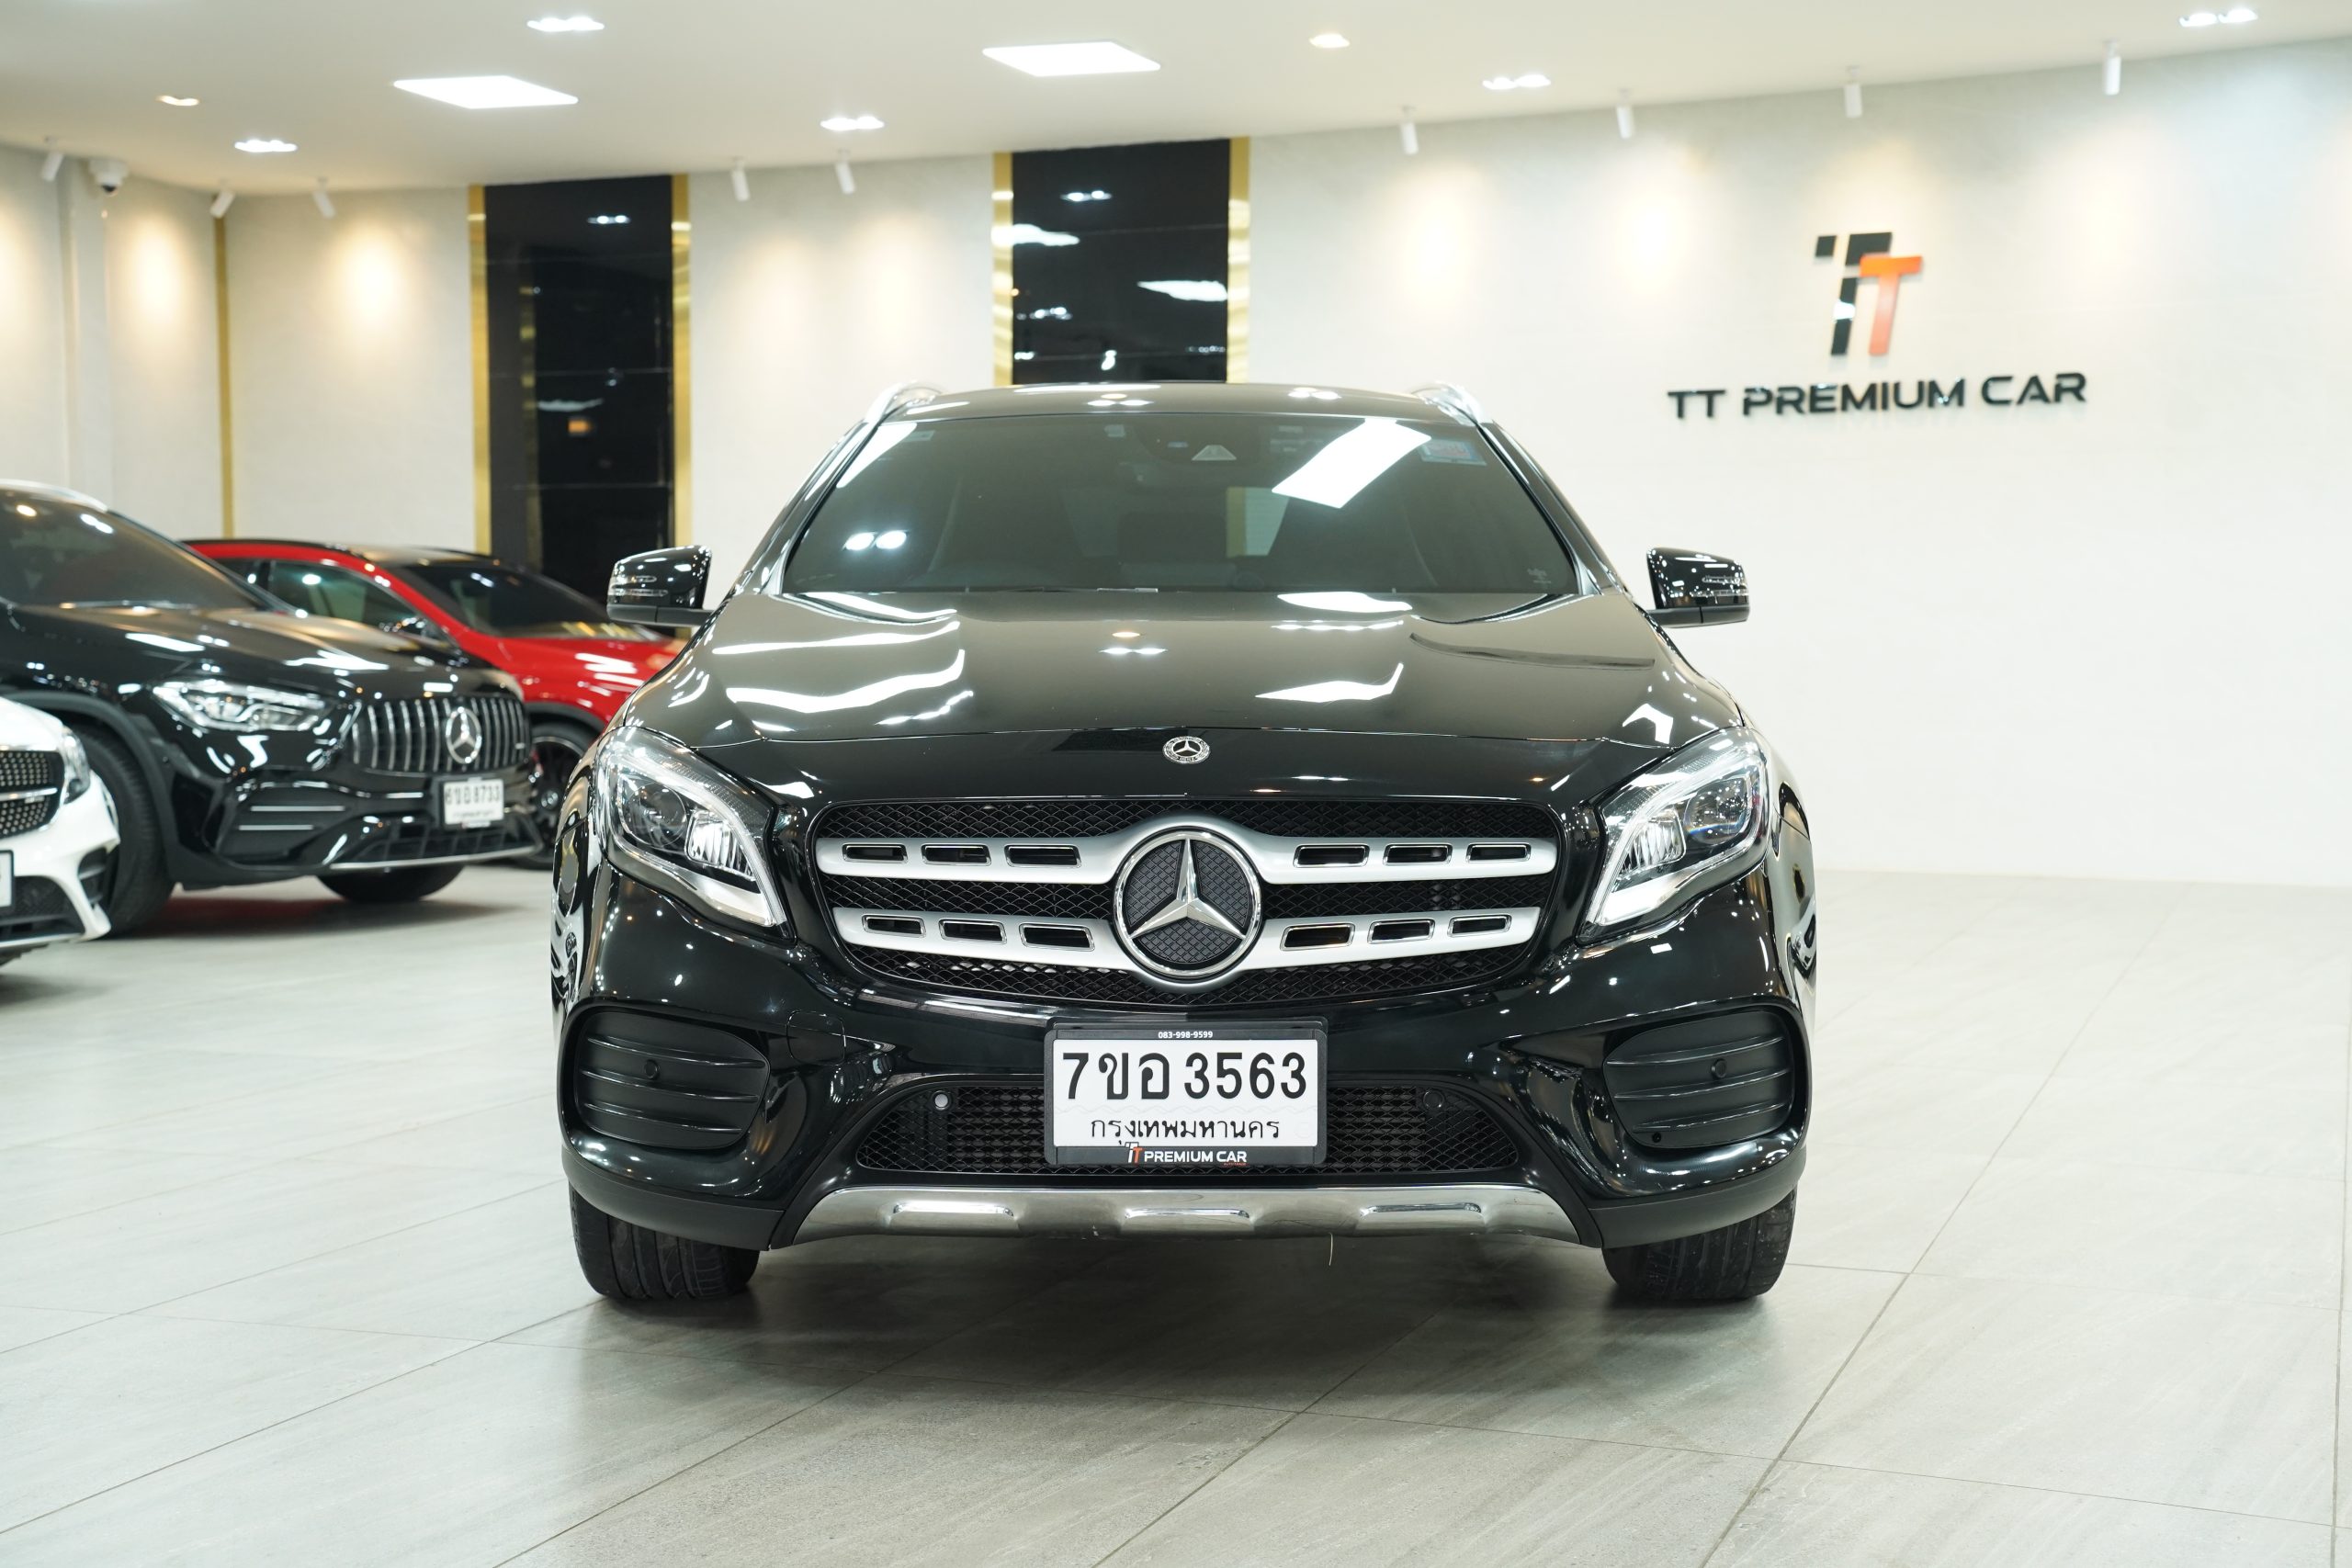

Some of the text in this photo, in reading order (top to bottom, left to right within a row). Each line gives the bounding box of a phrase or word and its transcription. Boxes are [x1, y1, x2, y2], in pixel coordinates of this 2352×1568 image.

[1668, 372, 2087, 419] TT PREMIUM CAR
[1158, 1031, 1214, 1039] 083-998-9599
[1062, 1052, 1306, 1100] 7ขอ 3563
[1091, 1119, 1280, 1145] กรุงเทพมหานคร
[1144, 1150, 1214, 1163] PREMIUM
[1216, 1150, 1248, 1163] CAR
